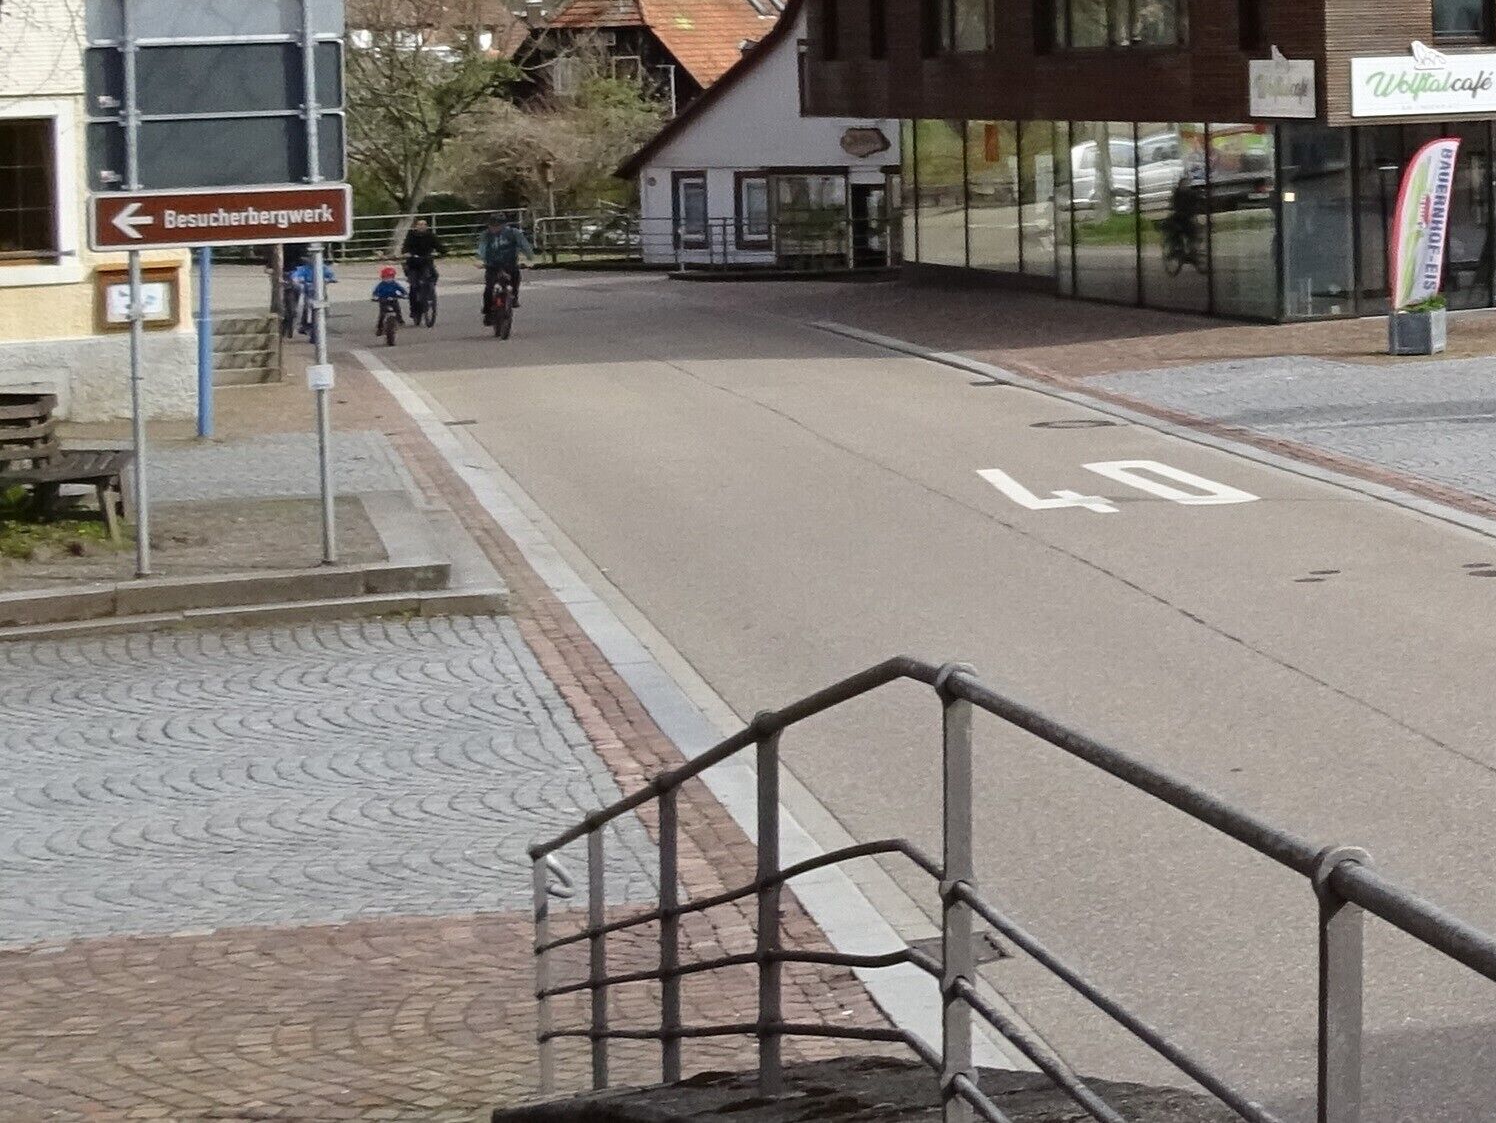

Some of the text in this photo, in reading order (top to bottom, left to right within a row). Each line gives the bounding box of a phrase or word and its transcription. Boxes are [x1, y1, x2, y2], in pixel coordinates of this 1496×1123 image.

[1365, 69, 1494, 101] Wolftalcafé
[163, 204, 335, 229] Besucherbergwerk
[1423, 148, 1453, 290] BAUERNHOF-EIS
[975, 460, 1262, 513] 40
